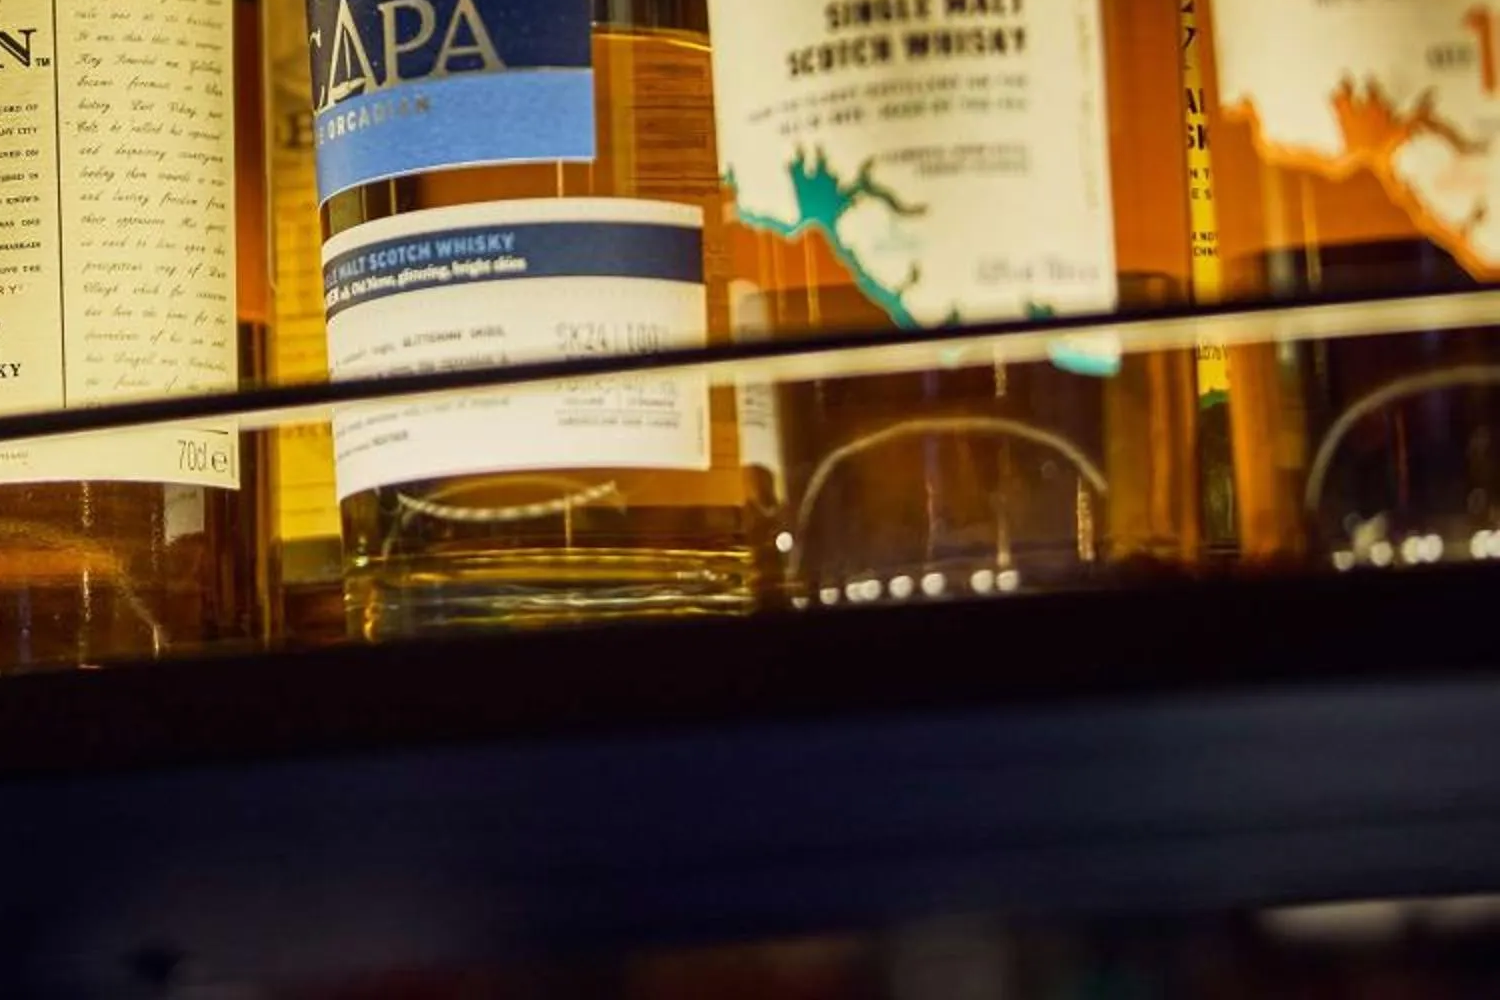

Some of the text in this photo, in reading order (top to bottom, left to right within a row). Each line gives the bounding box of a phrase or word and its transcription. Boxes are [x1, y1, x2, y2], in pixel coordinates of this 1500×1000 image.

[786, 26, 1026, 77] SCOTCH WHISKY
[1461, 2, 1499, 96] 1
[339, 255, 366, 280] MALT
[368, 240, 432, 271] SCOTCH
[434, 231, 516, 258] WHISKY
[176, 438, 209, 473] 70cl
